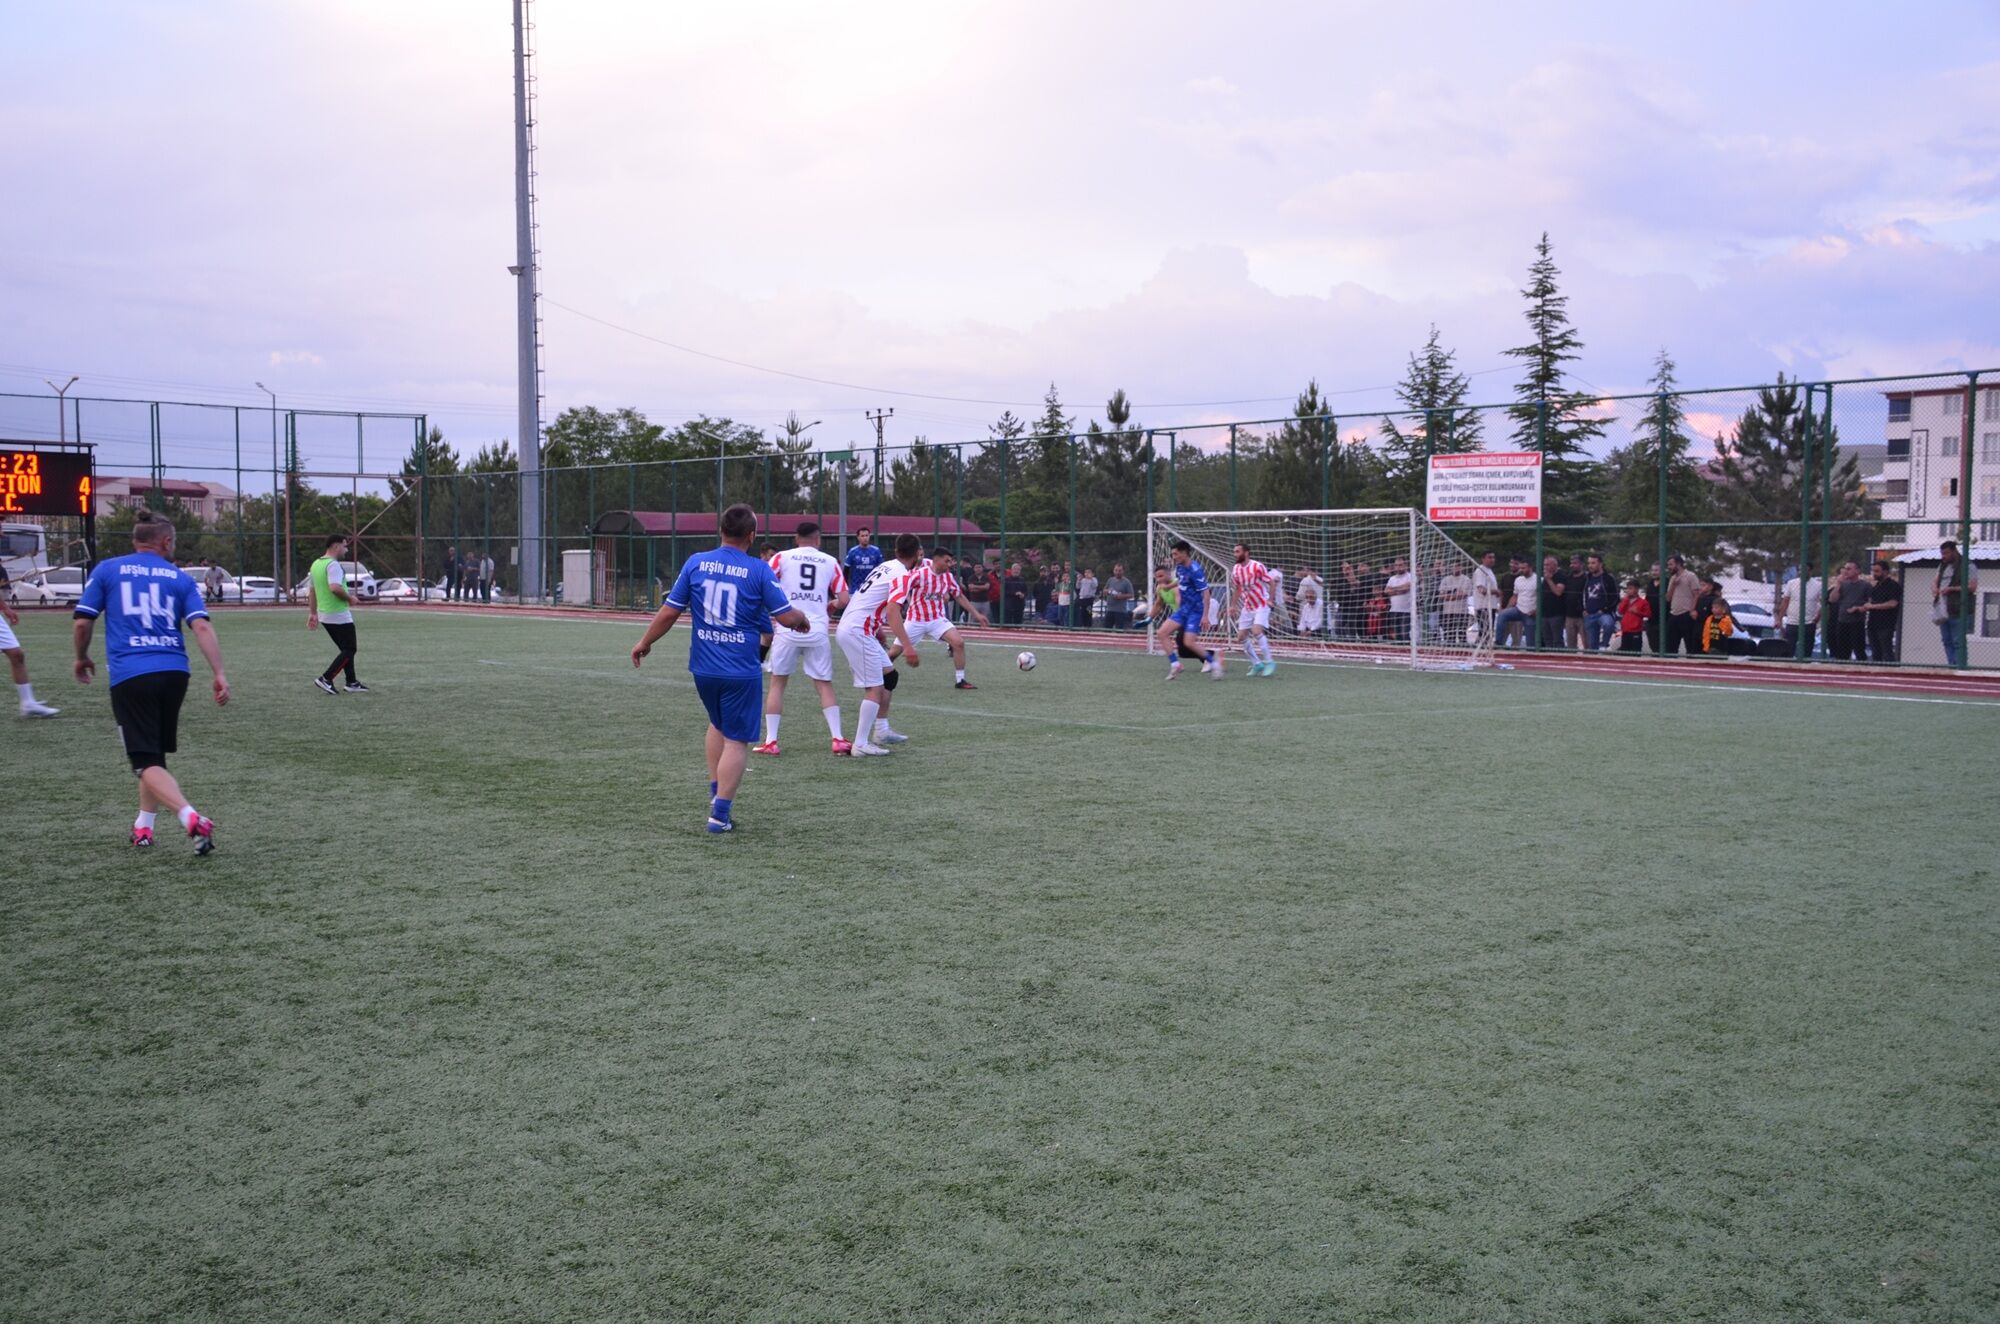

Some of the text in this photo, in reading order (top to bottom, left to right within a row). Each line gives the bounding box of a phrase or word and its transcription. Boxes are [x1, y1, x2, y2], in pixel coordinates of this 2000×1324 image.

[79, 476, 91, 495] 4
[79, 495, 88, 514] 1
[120, 564, 149, 578] AFŞİN
[698, 560, 749, 578] AFŞİN AKDO
[799, 563, 816, 591] 9
[120, 581, 177, 630] 44
[701, 579, 738, 627] 10
[790, 592, 823, 603] DAMLA
